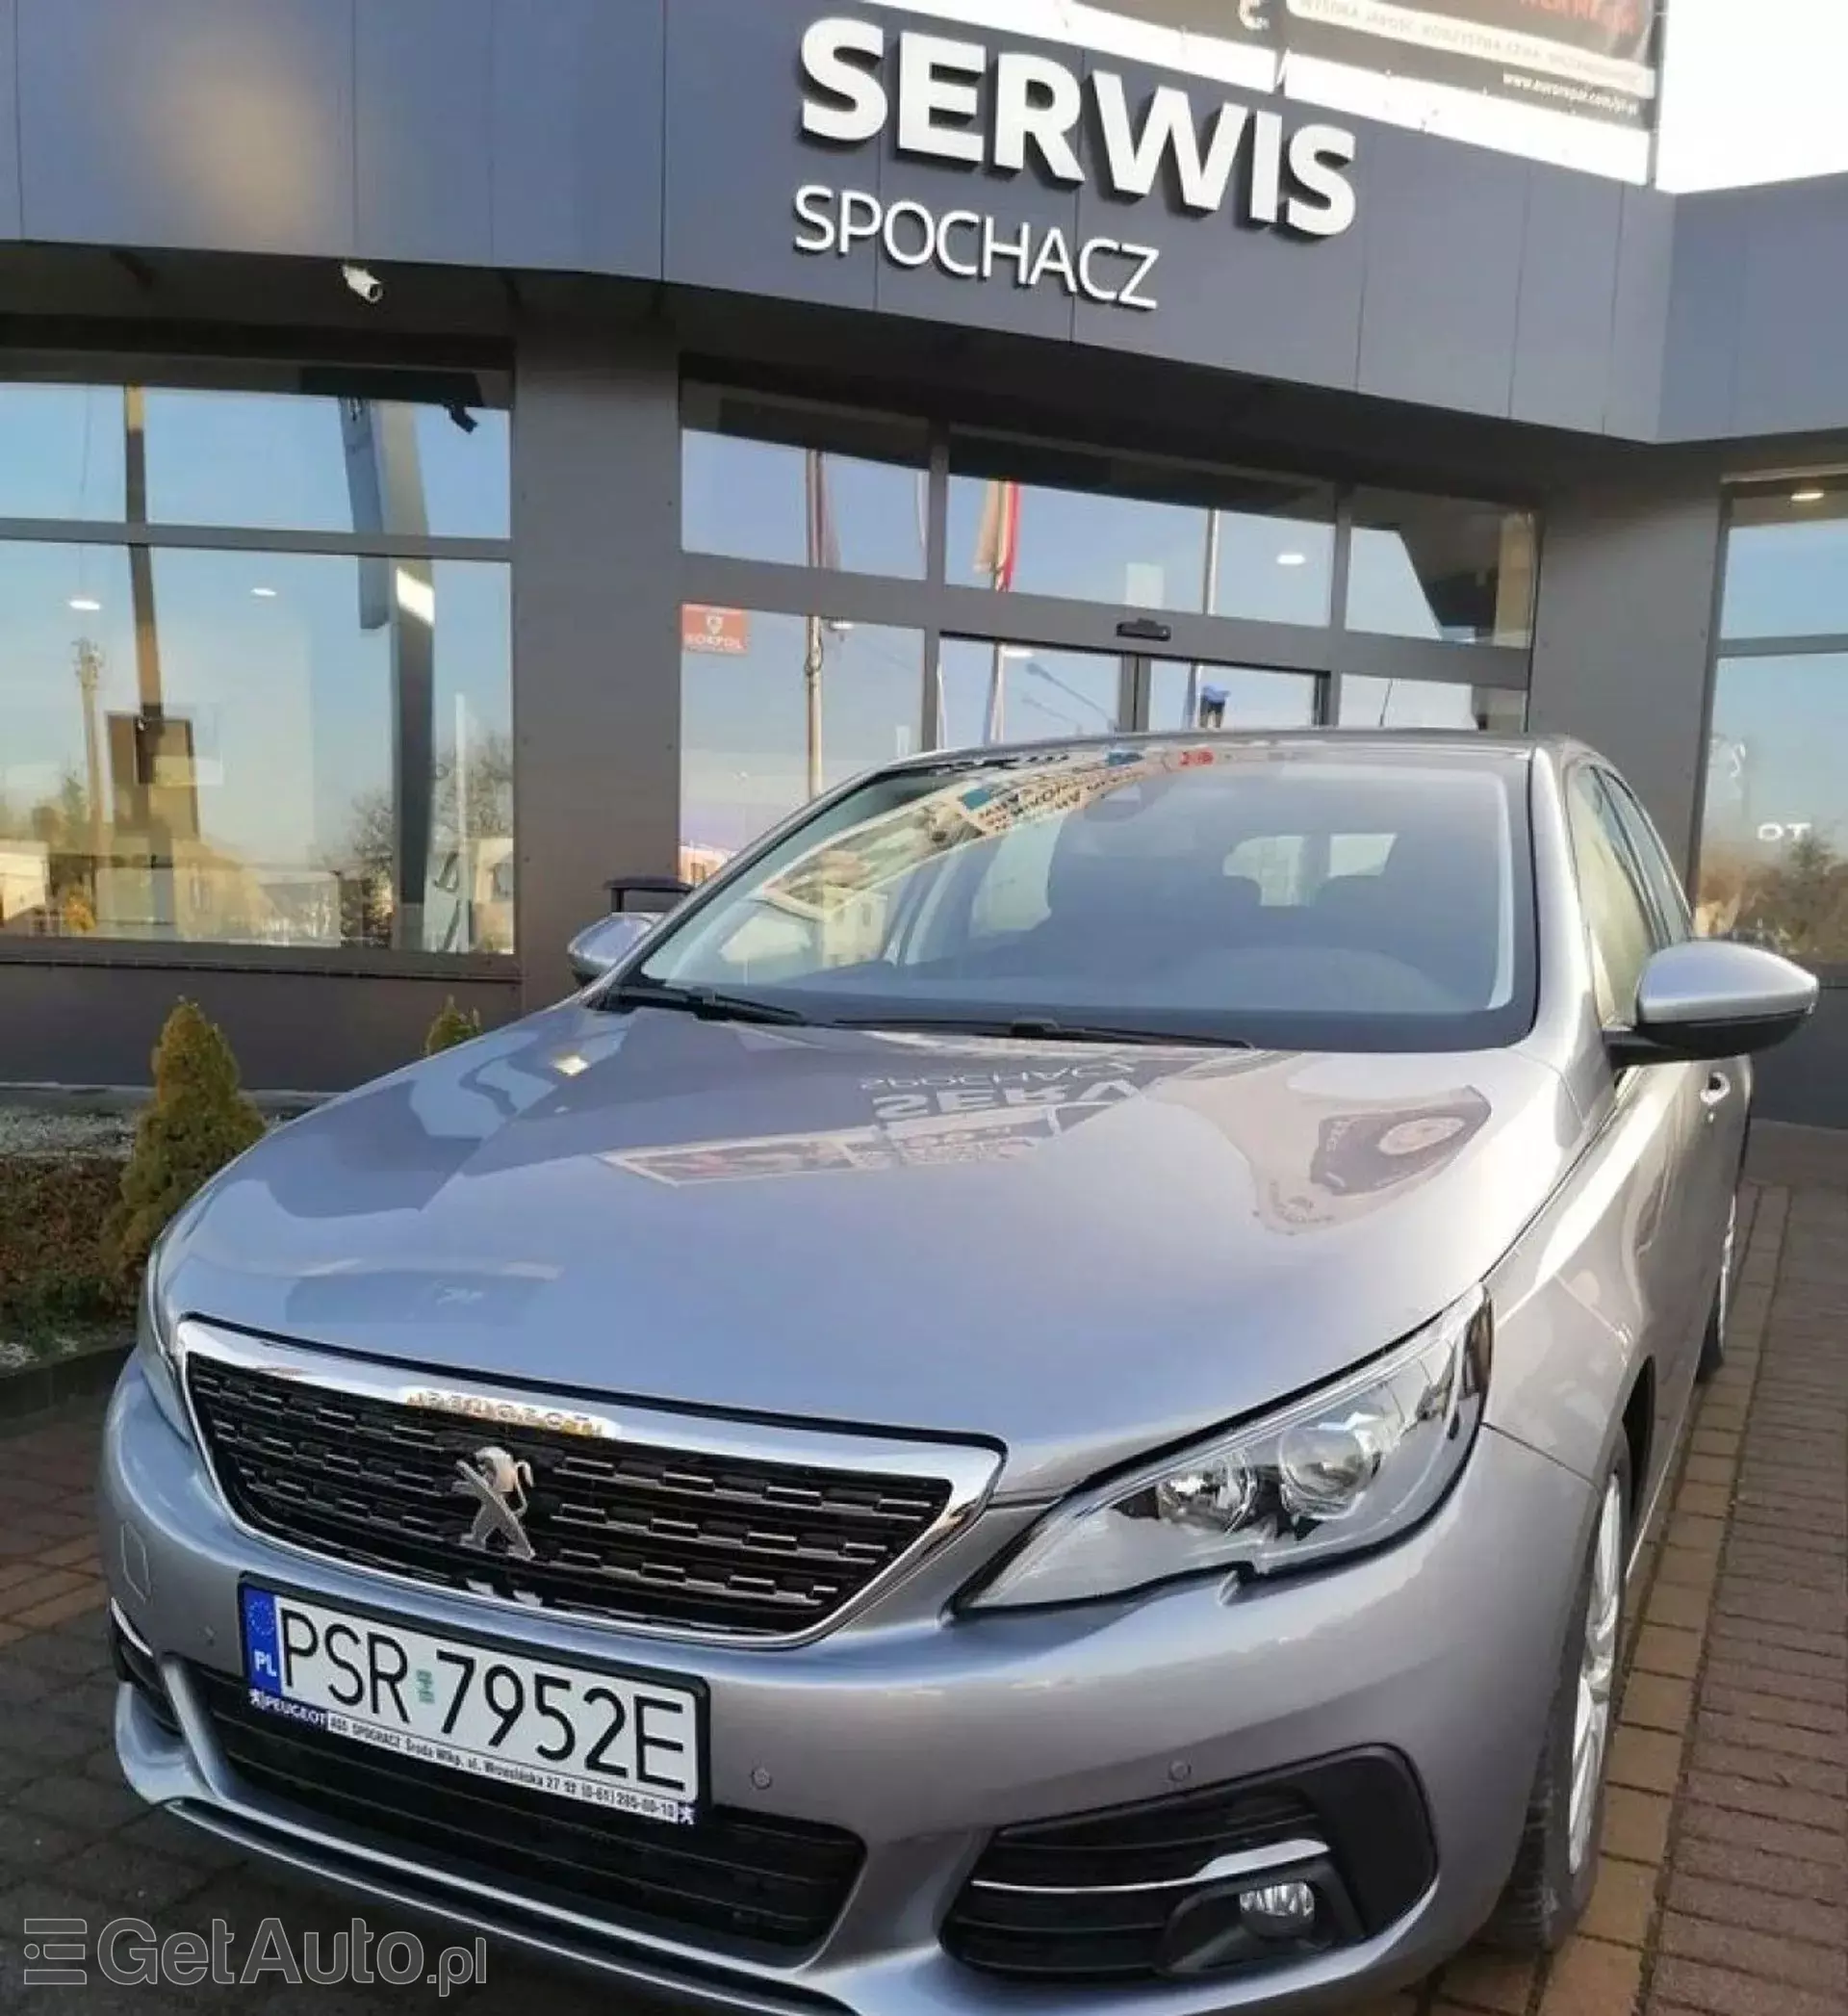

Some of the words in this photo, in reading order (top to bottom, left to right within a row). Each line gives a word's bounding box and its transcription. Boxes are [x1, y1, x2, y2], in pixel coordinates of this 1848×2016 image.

[800, 17, 1357, 237] SERWIS
[793, 185, 1159, 310] SPOCHACZ
[253, 1651, 277, 1678] PL
[281, 1607, 409, 1722] PSR
[436, 1650, 685, 1792] 7952E
[265, 1694, 325, 1726] PEUGEOT
[546, 1776, 560, 1791] 27
